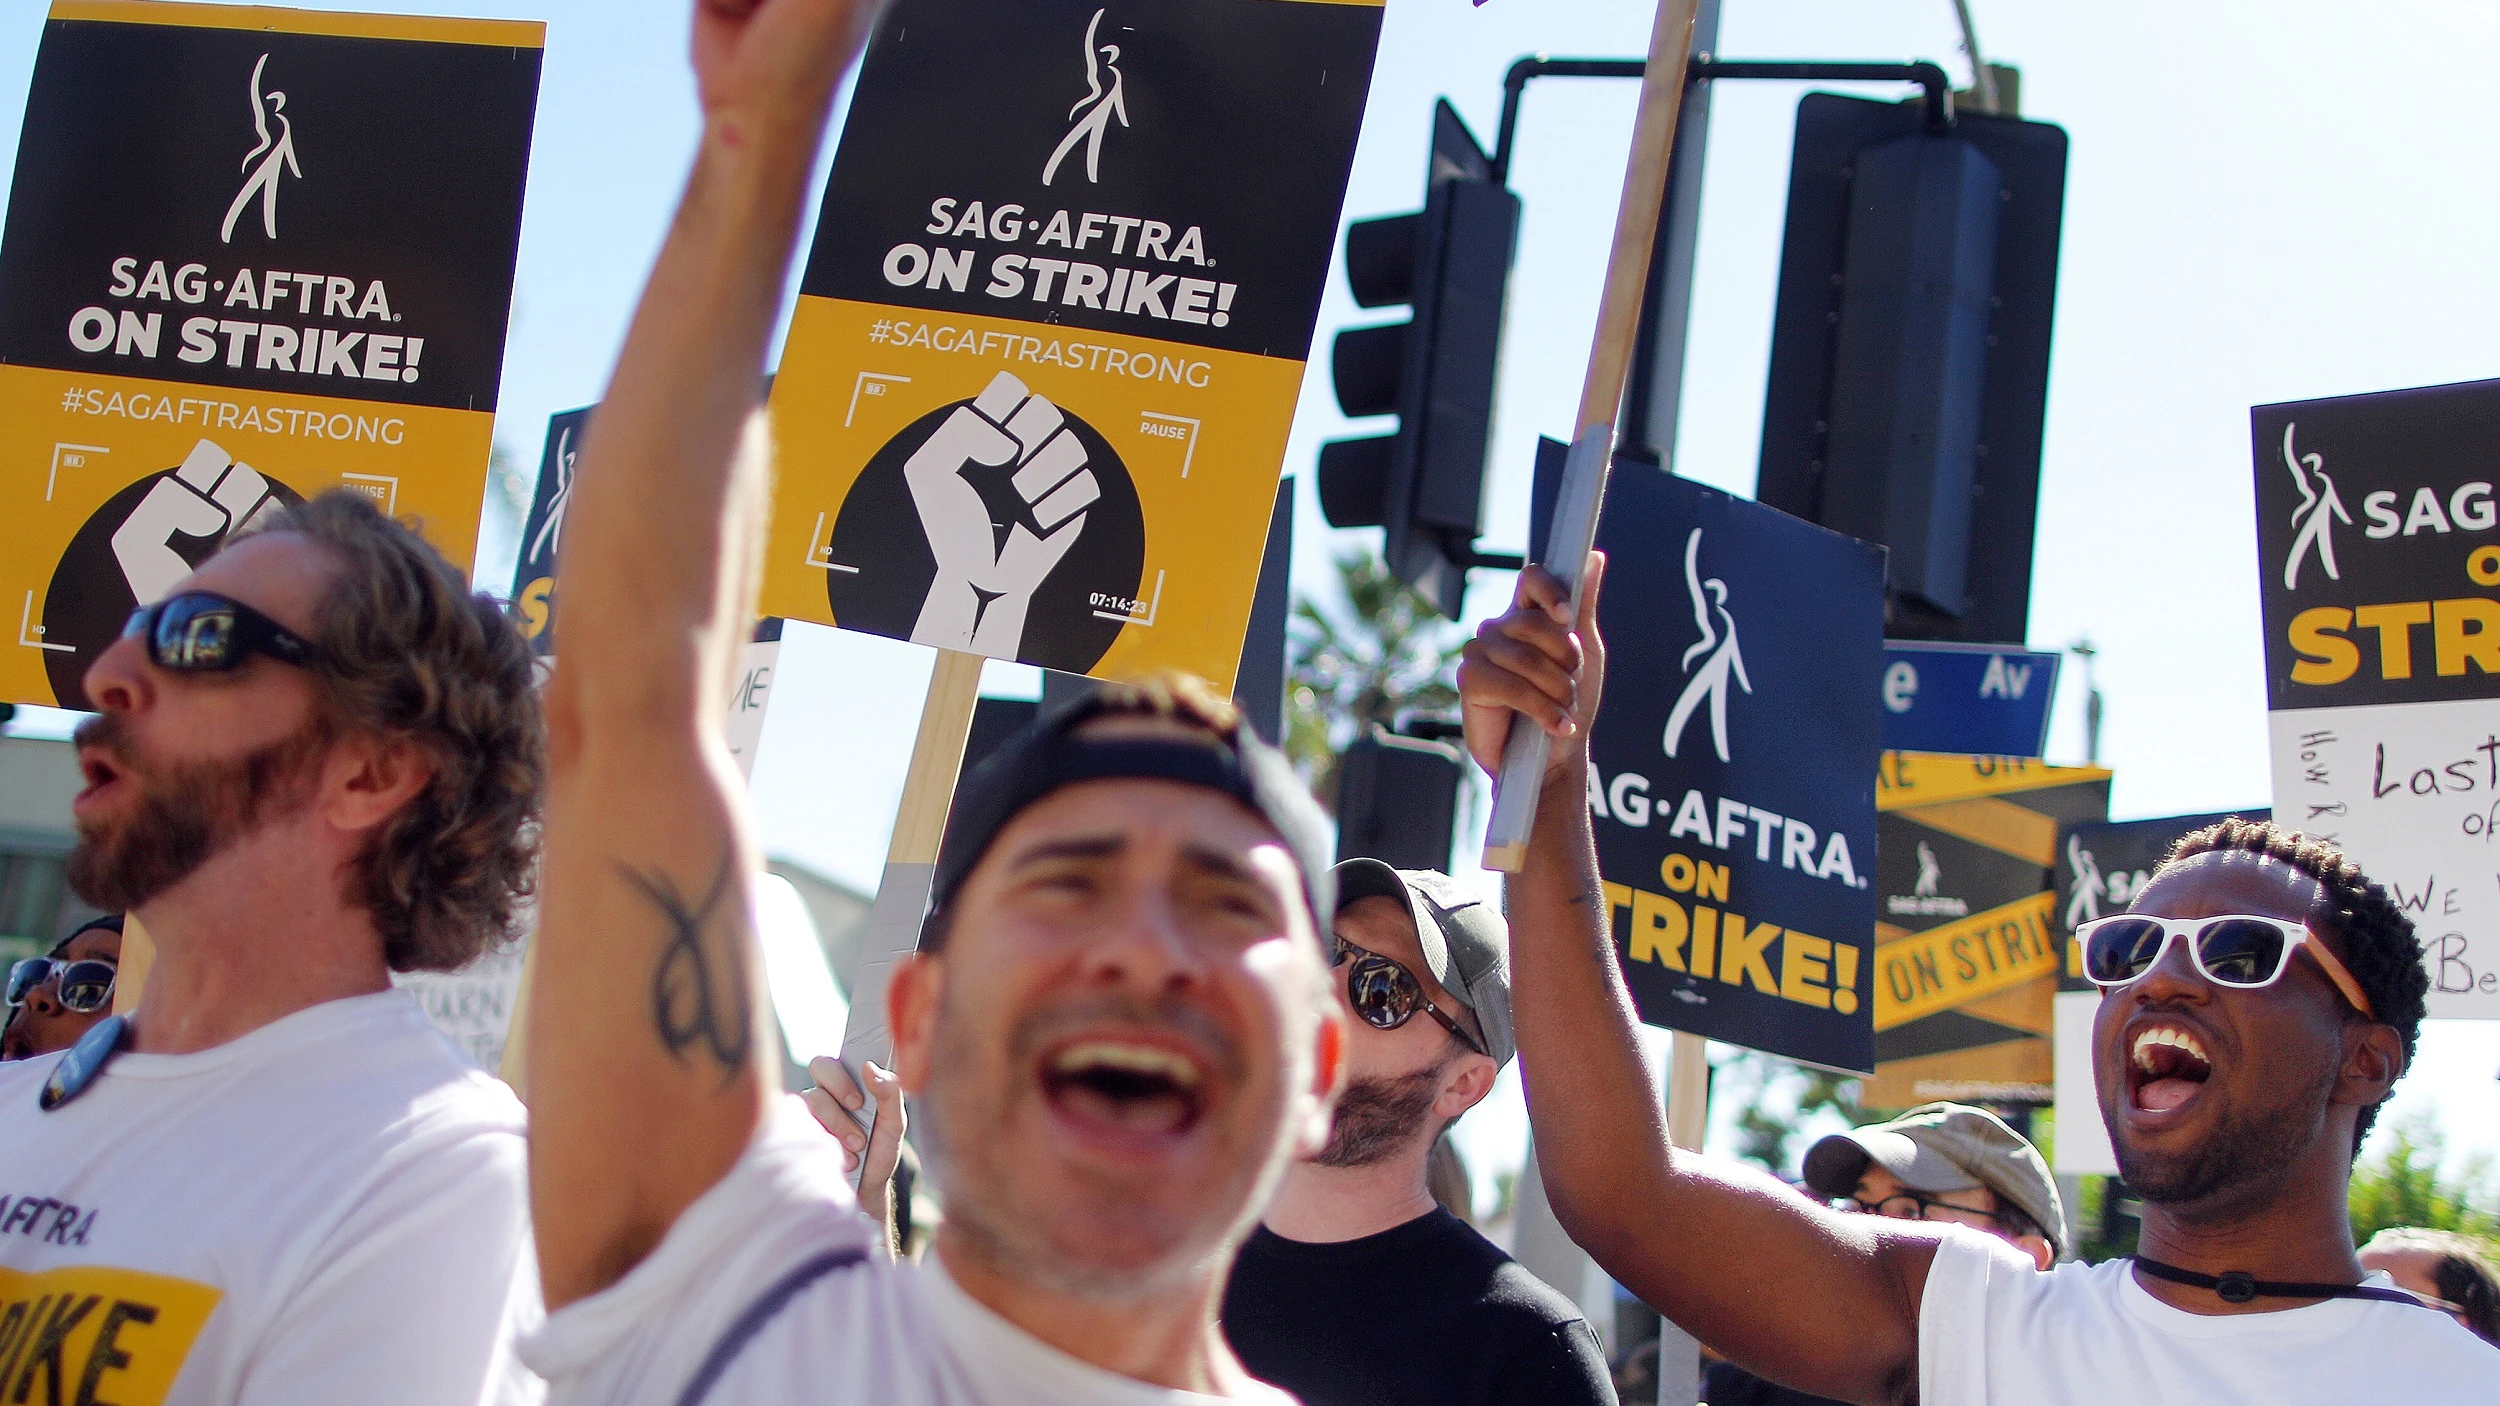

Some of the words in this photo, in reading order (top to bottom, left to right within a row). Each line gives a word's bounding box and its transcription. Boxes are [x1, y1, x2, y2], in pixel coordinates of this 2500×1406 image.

[882, 243, 976, 292] ON
[985, 253, 1238, 327] STRIKE!
[68, 306, 163, 358] ON
[177, 316, 425, 384] STRIKE!
[868, 318, 1213, 389] #SAGAFTRASTRONG
[61, 386, 406, 446] #SAGAFTRASTRONG
[1139, 421, 1187, 440] PAUSE
[1089, 592, 1148, 614] 07:14:23
[1978, 654, 2033, 700] Av
[2372, 733, 2500, 799] Last
[1660, 853, 1731, 903] ON
[1600, 879, 1860, 1015] TRIKE!
[1886, 947, 1944, 1004] ON
